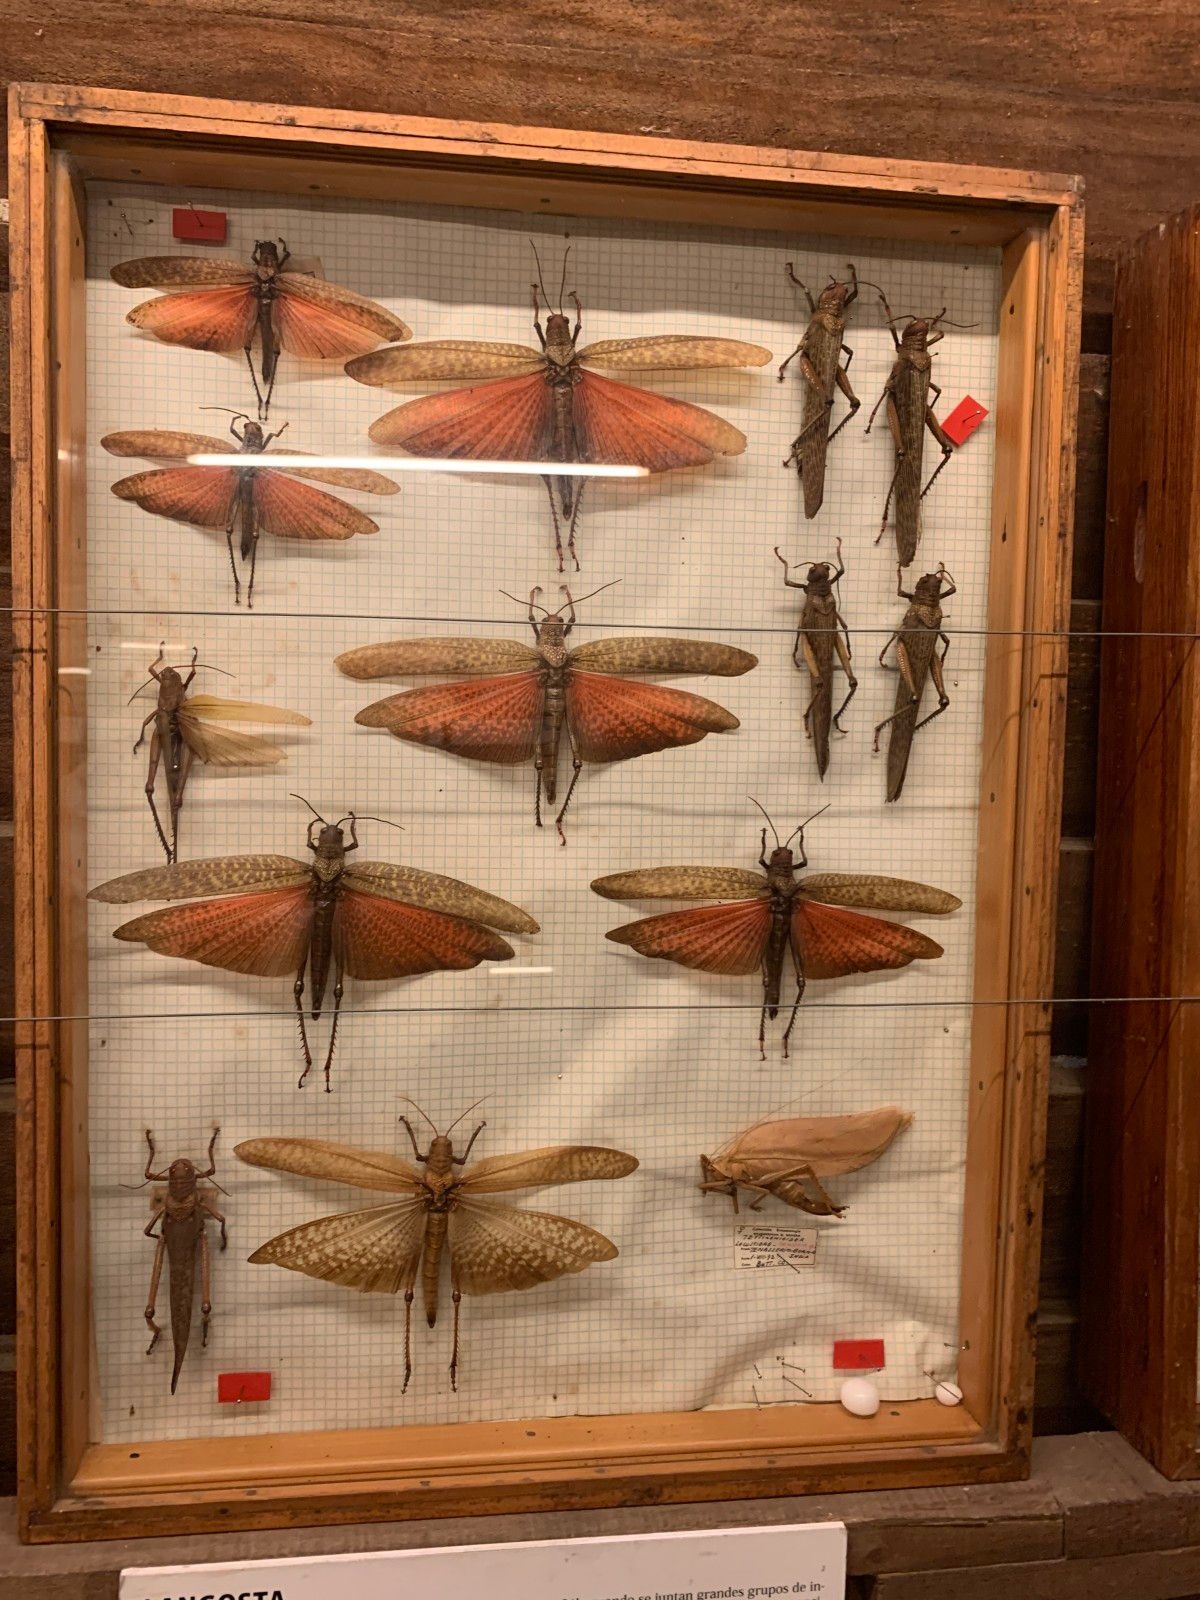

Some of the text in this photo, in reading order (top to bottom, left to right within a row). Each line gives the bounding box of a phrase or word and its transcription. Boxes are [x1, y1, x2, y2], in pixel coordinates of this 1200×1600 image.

[697, 1586, 745, 1600] grandes
[747, 1584, 789, 1599] grupos
[792, 1581, 807, 1593] de
[810, 1581, 825, 1592] in-
